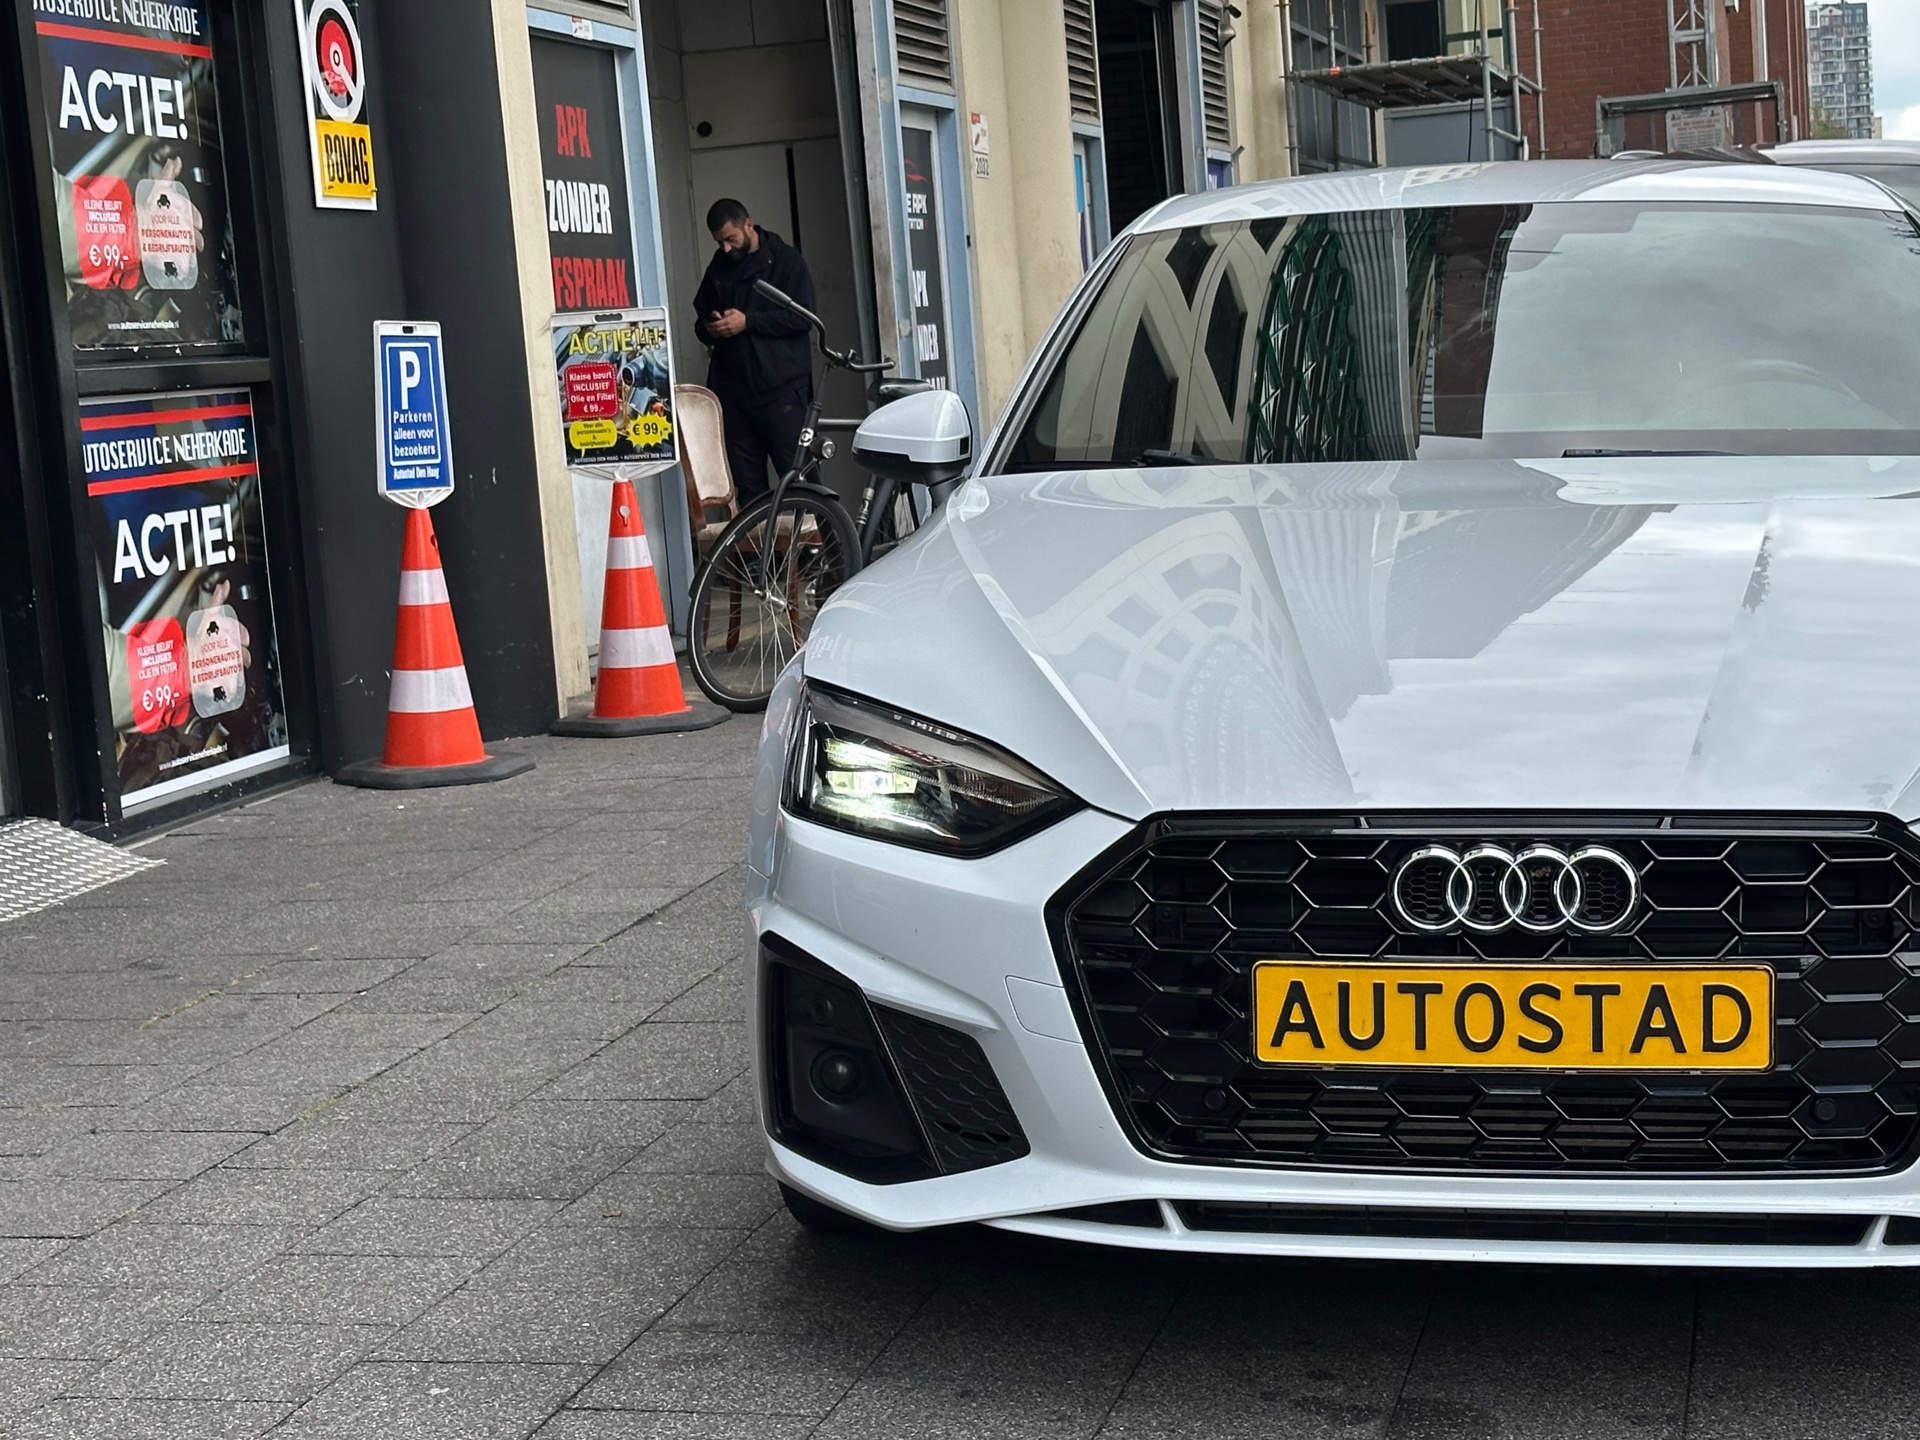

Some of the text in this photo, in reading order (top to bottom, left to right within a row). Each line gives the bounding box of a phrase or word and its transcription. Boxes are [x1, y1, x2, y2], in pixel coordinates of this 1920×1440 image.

[59, 66, 188, 140] ACTIE!
[555, 104, 592, 158] APK
[324, 133, 369, 186] BOVAG
[84, 200, 103, 210] KLEINE
[546, 179, 612, 234] ZONDER
[89, 244, 129, 270] € 99,-
[569, 327, 660, 356] ACTIE!!!
[399, 350, 421, 410] P
[569, 371, 612, 382] Kleine beurt
[573, 381, 609, 392] INCLUSIEF
[393, 411, 433, 424] Parkeren
[633, 422, 668, 437] € 99,-
[172, 428, 247, 462] NEHERKADE
[393, 427, 434, 440] alleen voor
[394, 443, 436, 457] bezoekers
[393, 466, 440, 480] Autostad Den Haag
[113, 504, 237, 584] ACTIE!
[136, 643, 156, 657] KLEINE
[142, 684, 180, 711] € 99,-
[1270, 979, 1752, 1054] AUTOSTAD
